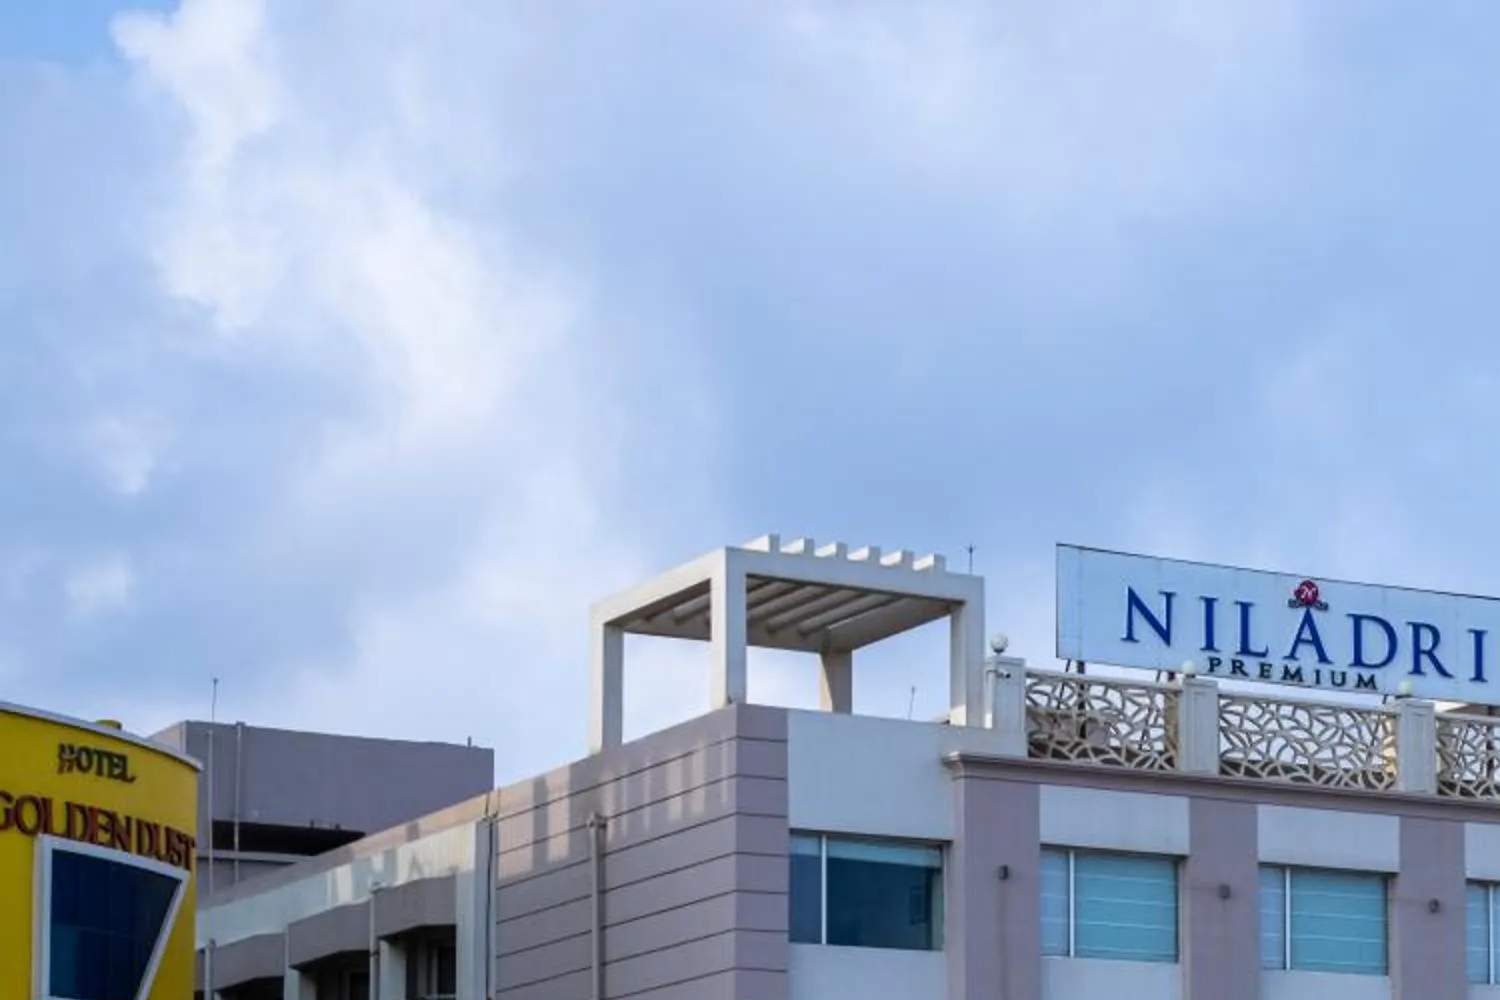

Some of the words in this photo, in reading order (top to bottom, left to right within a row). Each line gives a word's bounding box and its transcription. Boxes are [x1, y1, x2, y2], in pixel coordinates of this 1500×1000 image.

[1120, 586, 1489, 684] NILADRI
[1207, 657, 1379, 690] PREMIUM
[58, 743, 137, 783] HOTEL
[0, 790, 133, 851] GOLDEN
[135, 816, 196, 871] DUST
